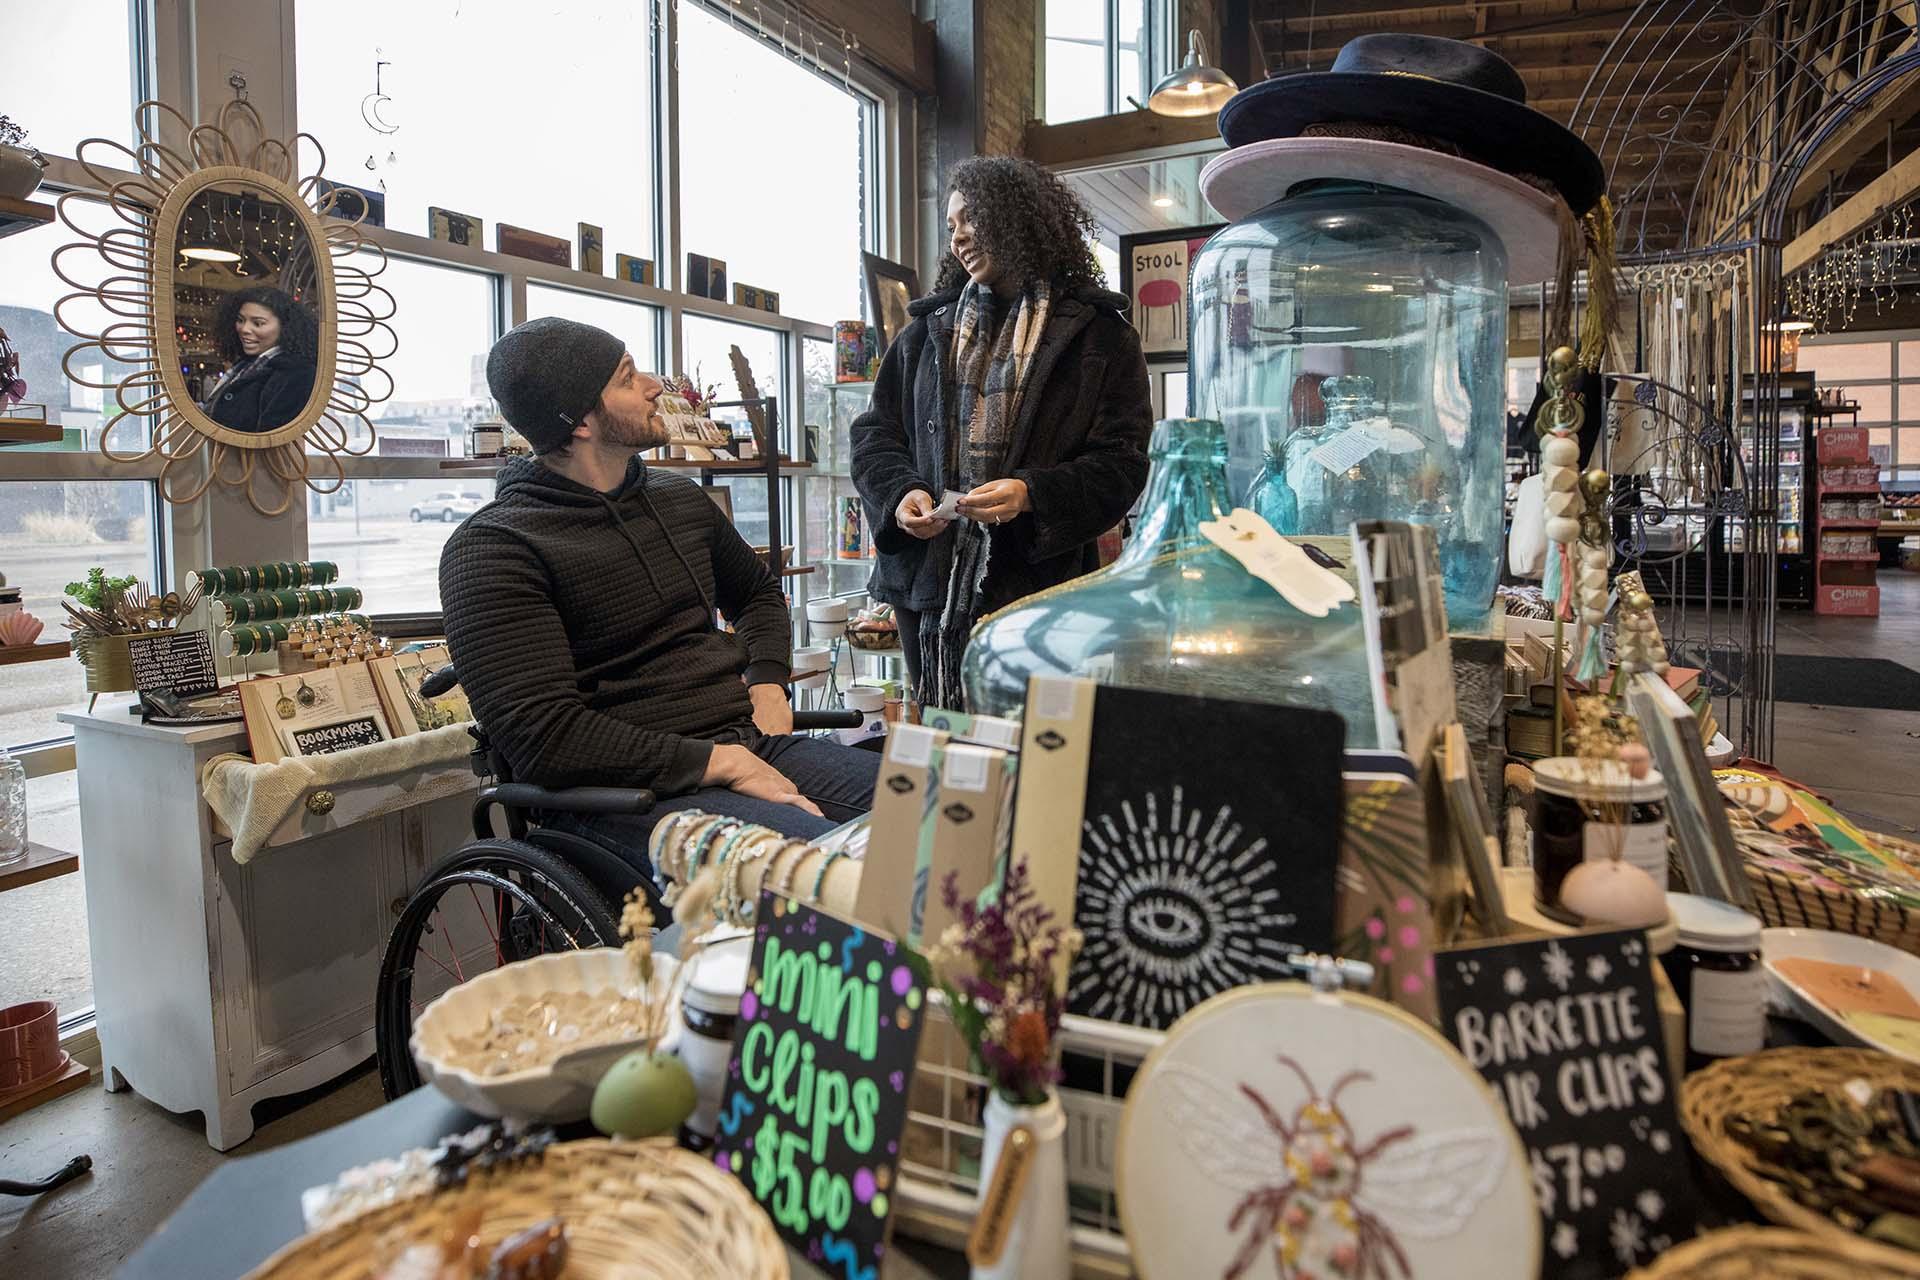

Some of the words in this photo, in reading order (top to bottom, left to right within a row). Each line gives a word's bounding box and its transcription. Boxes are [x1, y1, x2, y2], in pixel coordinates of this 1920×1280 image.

[1136, 251, 1182, 272] STOOL
[1823, 433, 1860, 446] CHUNK
[1830, 588, 1869, 601] CHUNK
[133, 658, 155, 666] METAL
[136, 670, 162, 678] GARDEN
[167, 672, 184, 680] TAGS
[138, 680, 175, 690] KEYCHAINS
[296, 721, 373, 747] BOOKMARKS
[761, 936, 883, 1061] mini
[1455, 986, 1645, 1070] BARRETTE
[1557, 1046, 1665, 1116] CLIPS
